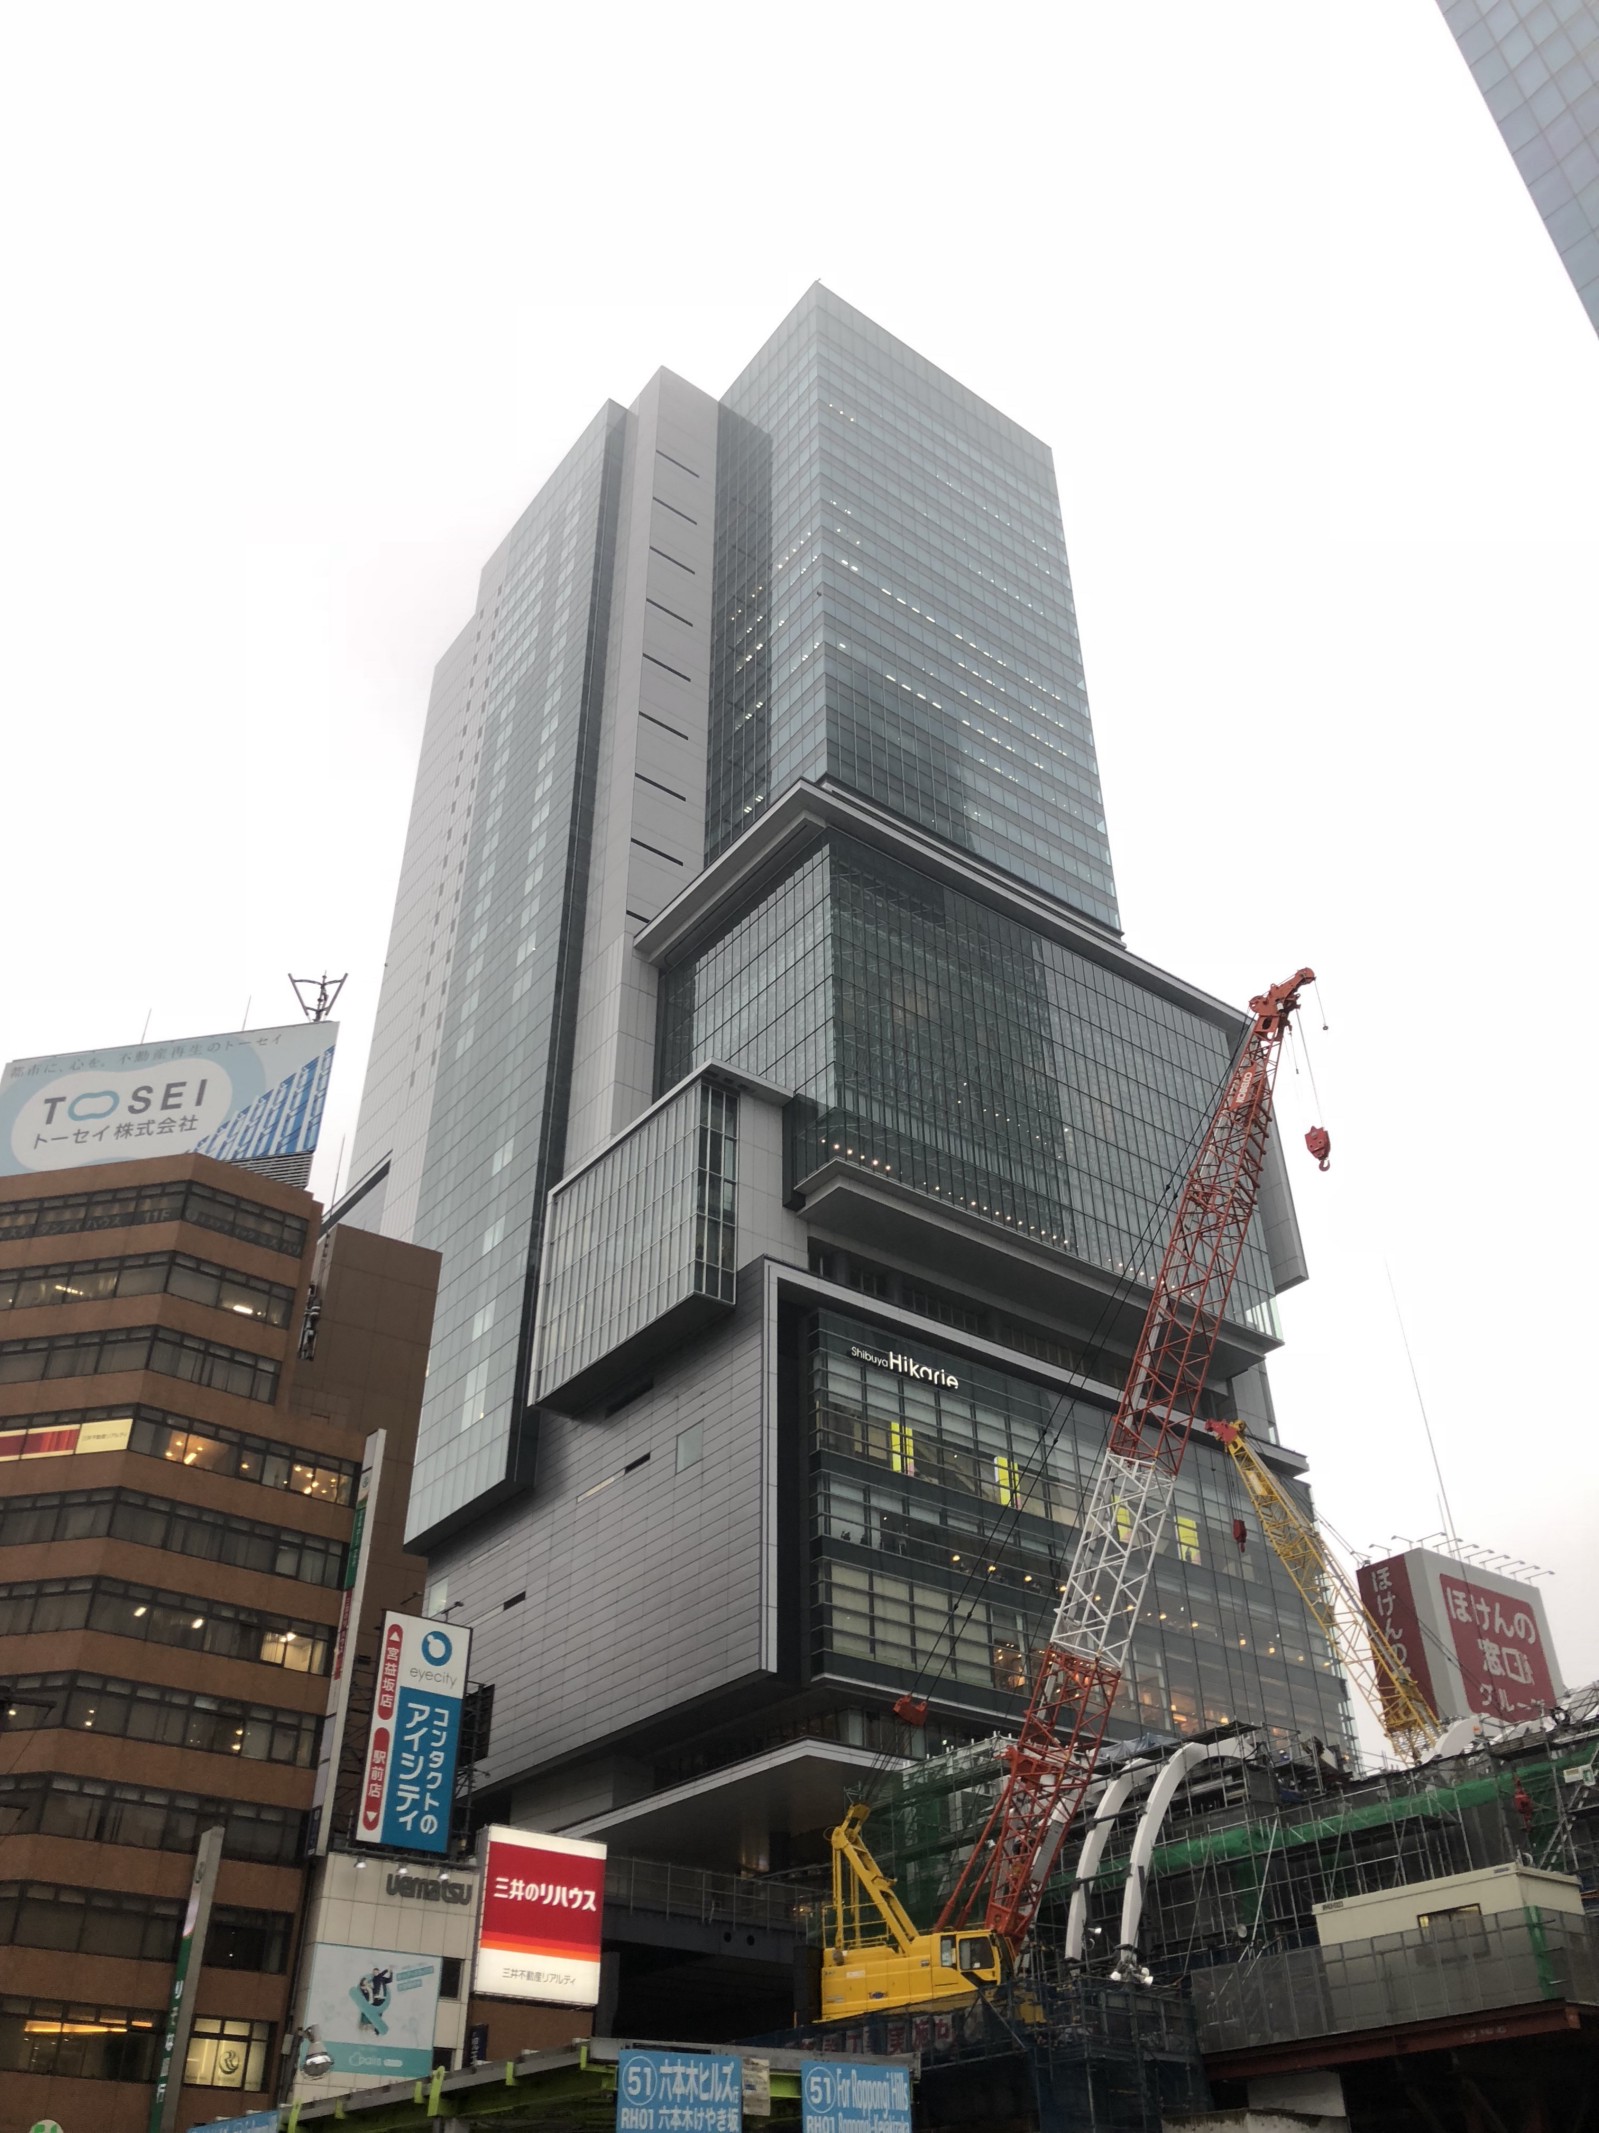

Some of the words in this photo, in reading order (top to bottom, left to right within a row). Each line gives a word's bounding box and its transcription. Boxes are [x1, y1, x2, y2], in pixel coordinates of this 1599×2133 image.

[43, 1078, 208, 1126] TOSEI
[851, 1345, 889, 1368] Shibuya
[888, 1350, 959, 1390] Hikarie
[1446, 1586, 1537, 1645] ほけんの
[379, 1646, 400, 1709] 宮益坂店
[409, 1666, 458, 1690] eyecity
[368, 1749, 387, 1799] 駅前店
[395, 1702, 431, 1832] アイシティ
[419, 1707, 450, 1835] コンタクトの
[493, 1876, 598, 1912] 三井のリハウス
[501, 1966, 577, 1986] 三井不動産リアルティ
[626, 2066, 652, 2096] 51
[809, 2076, 832, 2105] 51
[620, 2107, 655, 2131] RH01
[658, 2105, 740, 2132] 六本木けやき坂
